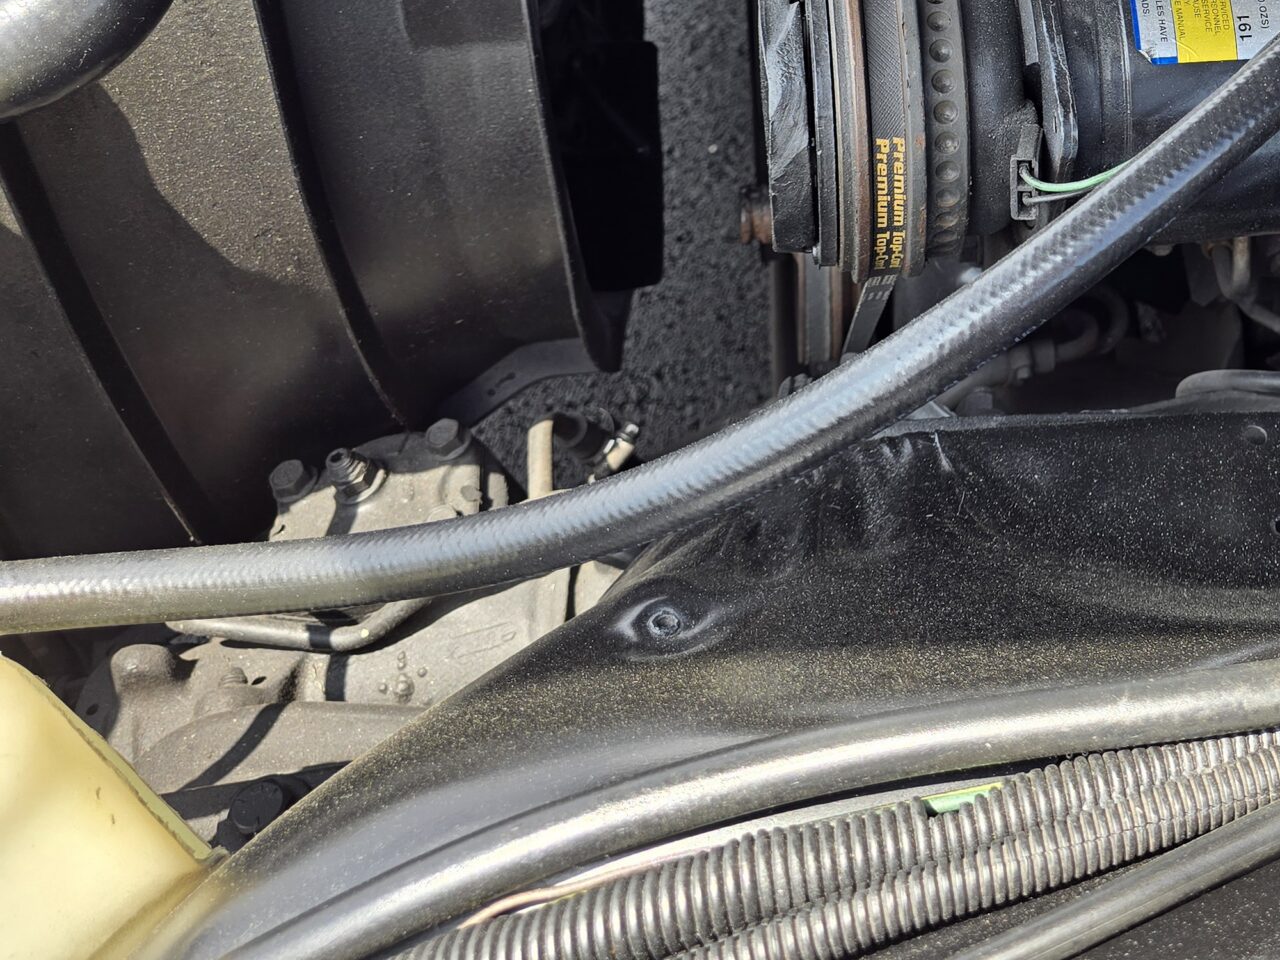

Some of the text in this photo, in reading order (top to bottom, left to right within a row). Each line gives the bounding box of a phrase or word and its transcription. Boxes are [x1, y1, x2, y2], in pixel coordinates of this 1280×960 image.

[1158, 19, 1169, 43] HAVE
[1175, 7, 1187, 39] MANUAL
[1201, 0, 1213, 33] SERVICE
[1259, 6, 1270, 29] OZS)
[875, 138, 891, 228] Premium
[893, 136, 907, 227] Premium
